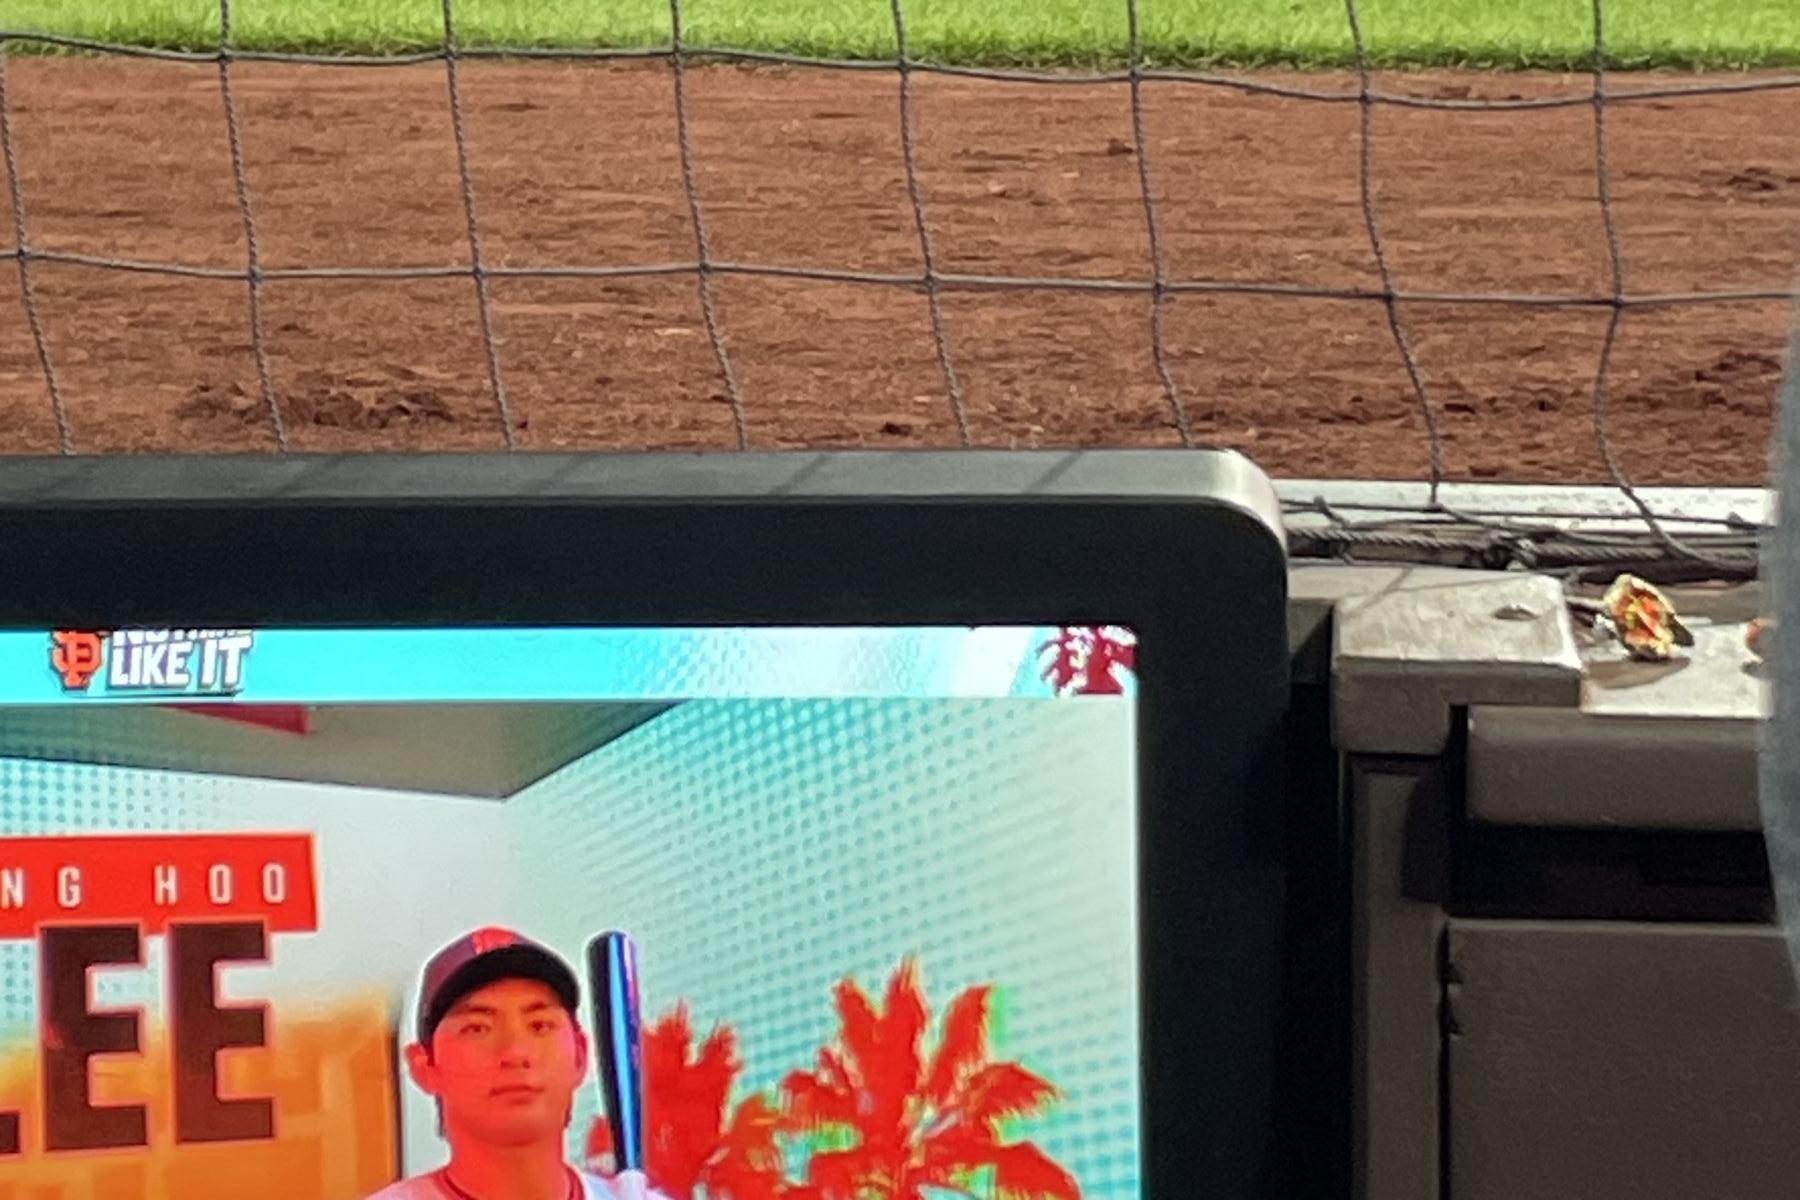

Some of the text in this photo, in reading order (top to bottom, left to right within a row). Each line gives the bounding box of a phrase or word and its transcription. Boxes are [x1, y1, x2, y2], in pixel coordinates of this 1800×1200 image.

[109, 636, 252, 686] LIKE IT
[154, 862, 287, 905] HOO
[0, 921, 280, 1153] EE
